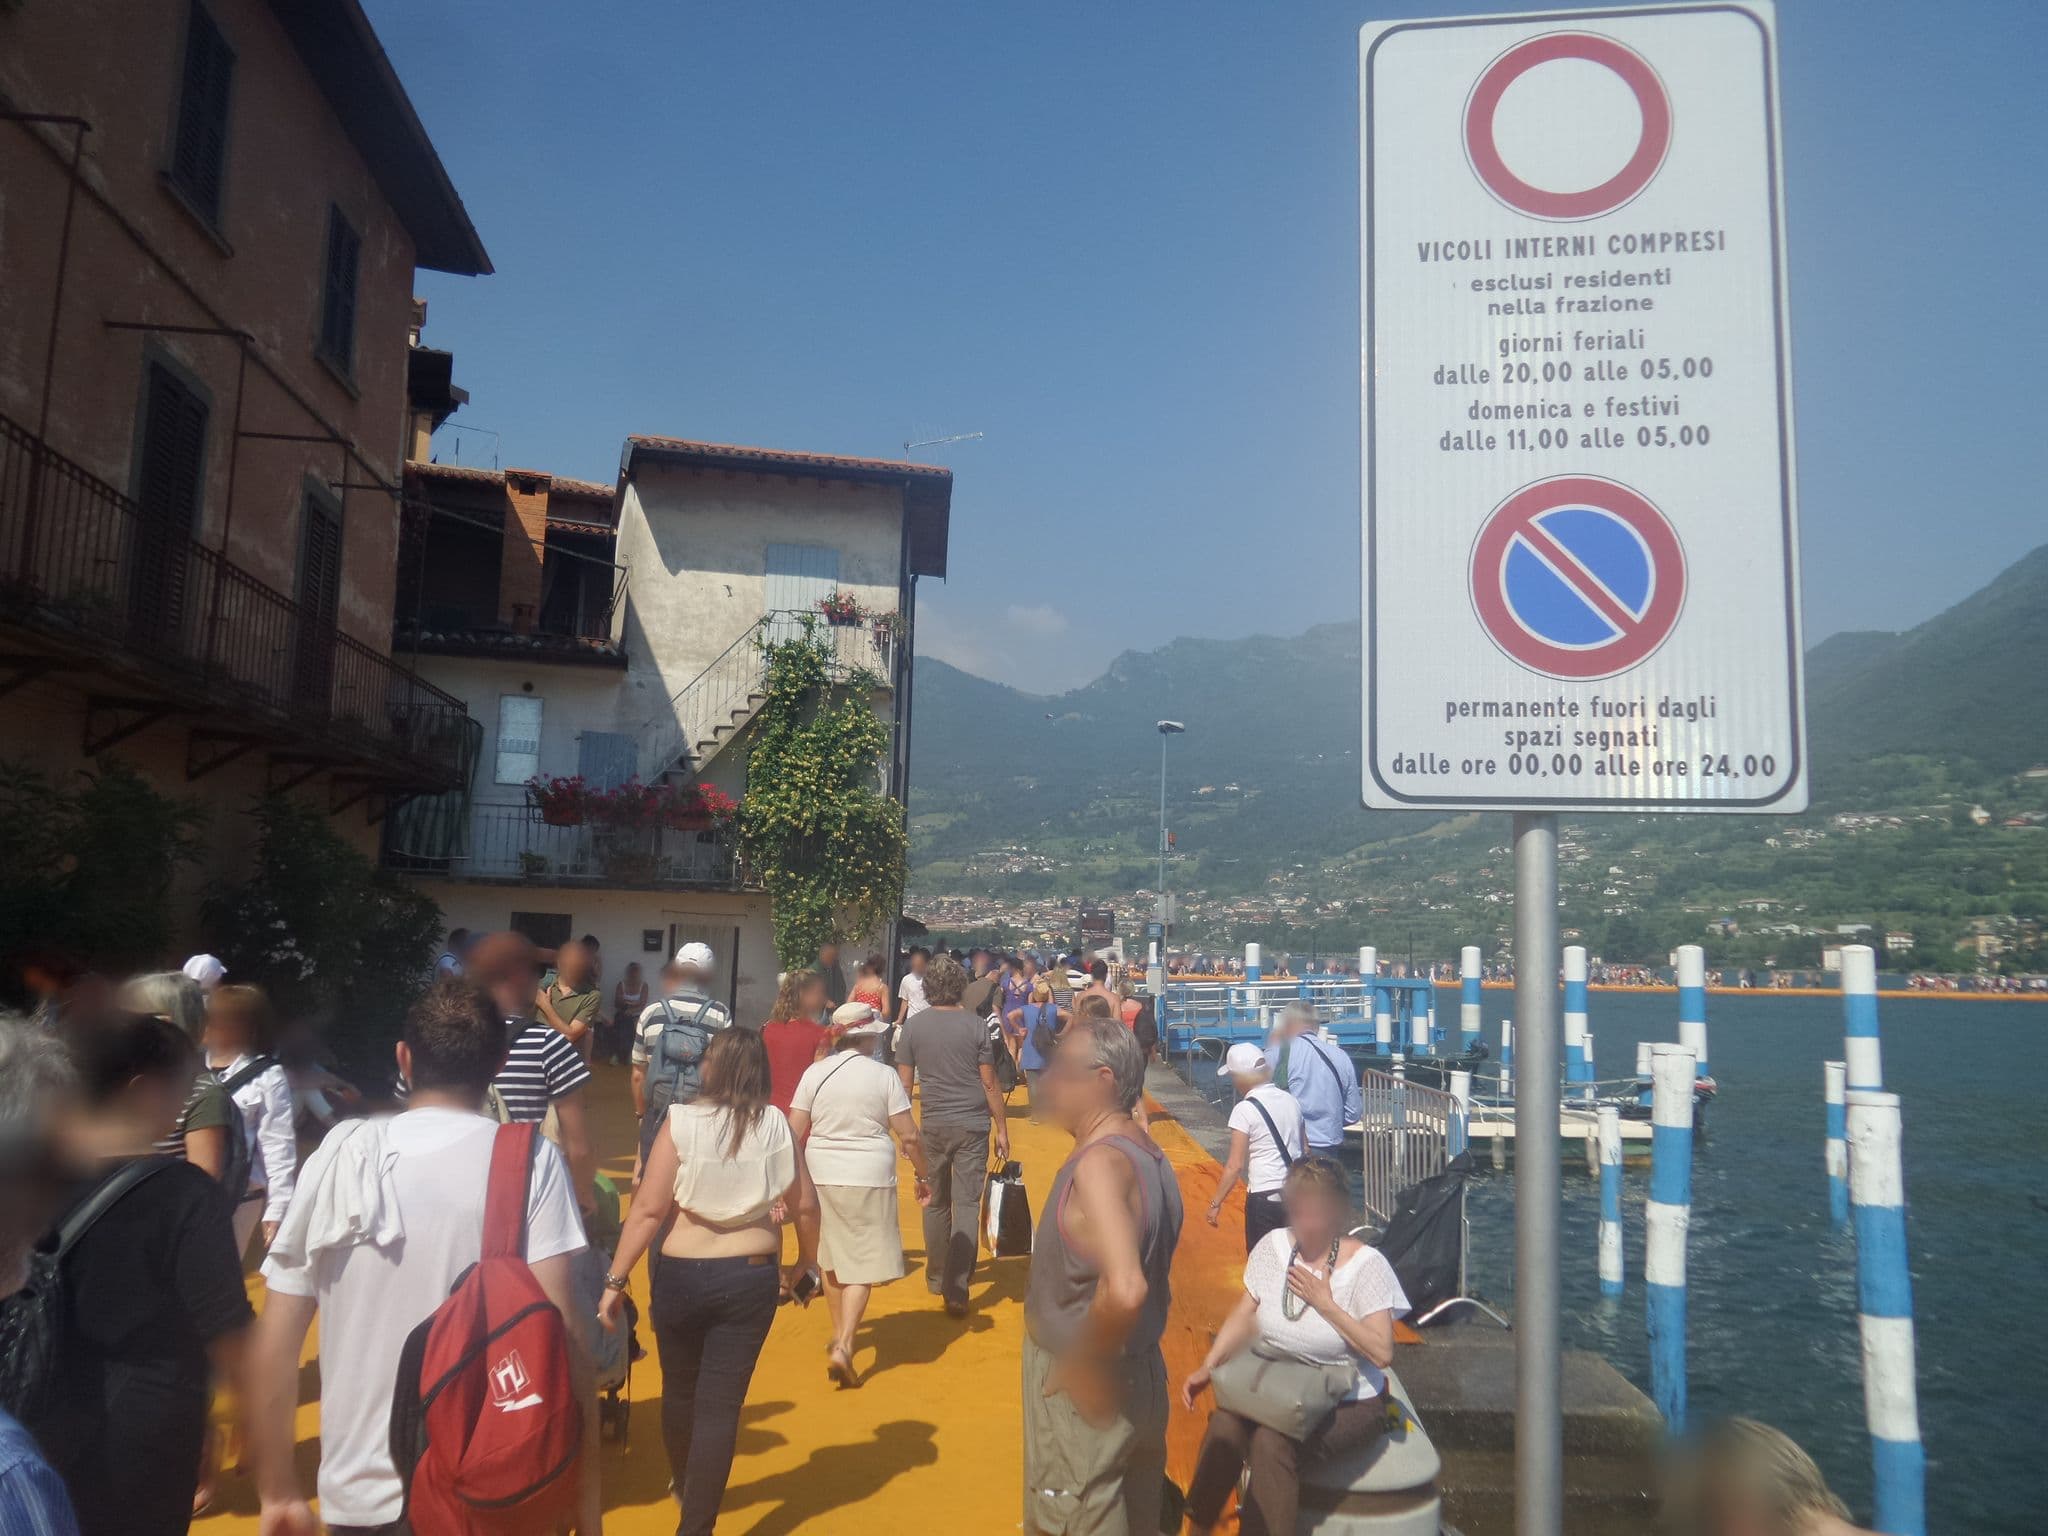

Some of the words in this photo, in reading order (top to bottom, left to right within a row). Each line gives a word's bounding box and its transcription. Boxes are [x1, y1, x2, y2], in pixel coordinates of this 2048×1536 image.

[1417, 239, 1491, 262] VICOLI
[1505, 234, 1594, 259] INTERNI
[1607, 229, 1724, 255] COMPRESI
[1470, 271, 1552, 292] esclusi
[1563, 267, 1671, 288] residenti
[1487, 297, 1546, 316] nella
[1554, 294, 1653, 313] frazione
[1498, 330, 1562, 358] giorni
[1572, 328, 1644, 351] feriali
[1432, 363, 1490, 385] dalle
[1583, 359, 1628, 381] alle
[1467, 397, 1572, 420] domenica
[1583, 402, 1595, 417] e
[1603, 394, 1679, 417] festivi
[1439, 429, 1496, 451] dalle
[1579, 426, 1624, 448] alle
[1445, 696, 1580, 724] permanente
[1589, 695, 1645, 718] fuori
[1657, 695, 1716, 723] dagli
[1504, 724, 1562, 751] spazi
[1573, 724, 1658, 750] segnati
[1391, 751, 1450, 774] dalle
[1460, 758, 1496, 775] ore
[1593, 753, 1640, 777] alle
[1651, 757, 1689, 776] ore
